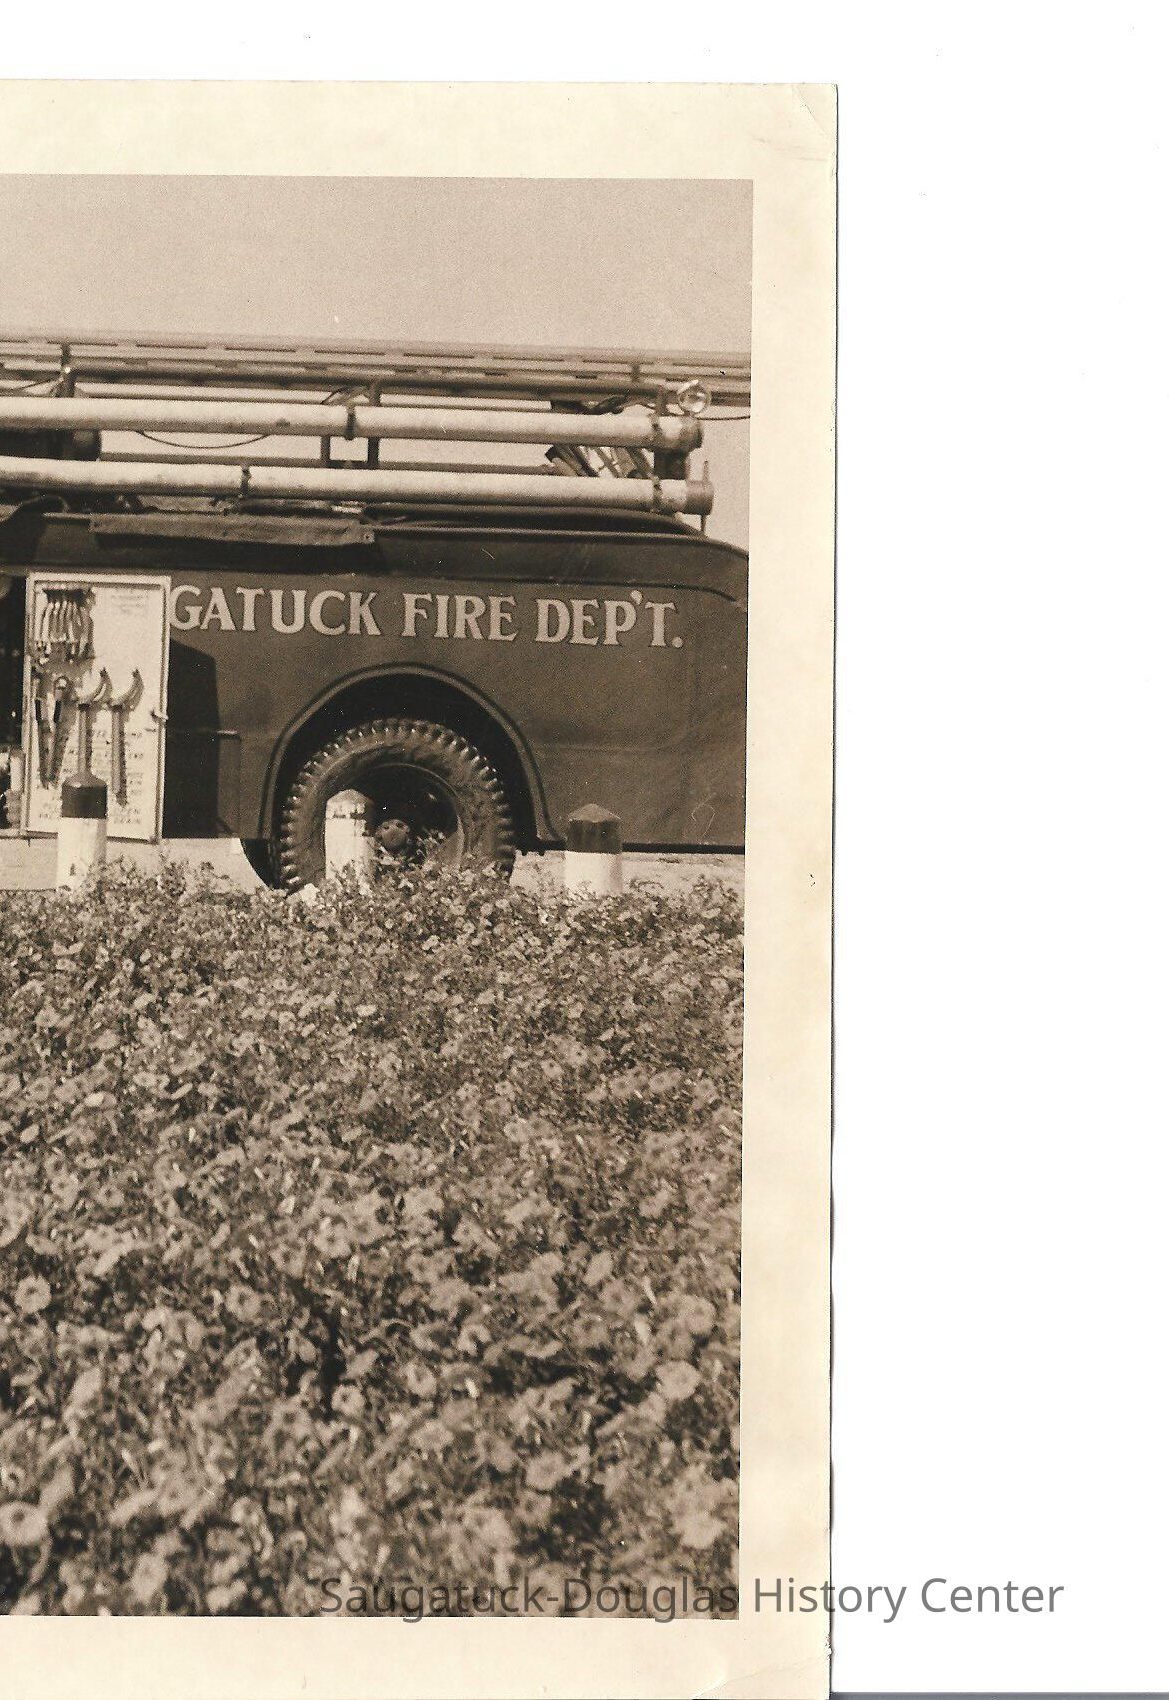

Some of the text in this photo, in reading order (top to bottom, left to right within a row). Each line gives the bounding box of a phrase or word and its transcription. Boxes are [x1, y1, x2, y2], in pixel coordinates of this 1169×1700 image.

[169, 584, 381, 636] GATUCK
[401, 593, 518, 641] FIRE
[535, 589, 684, 648] DEP'T.
